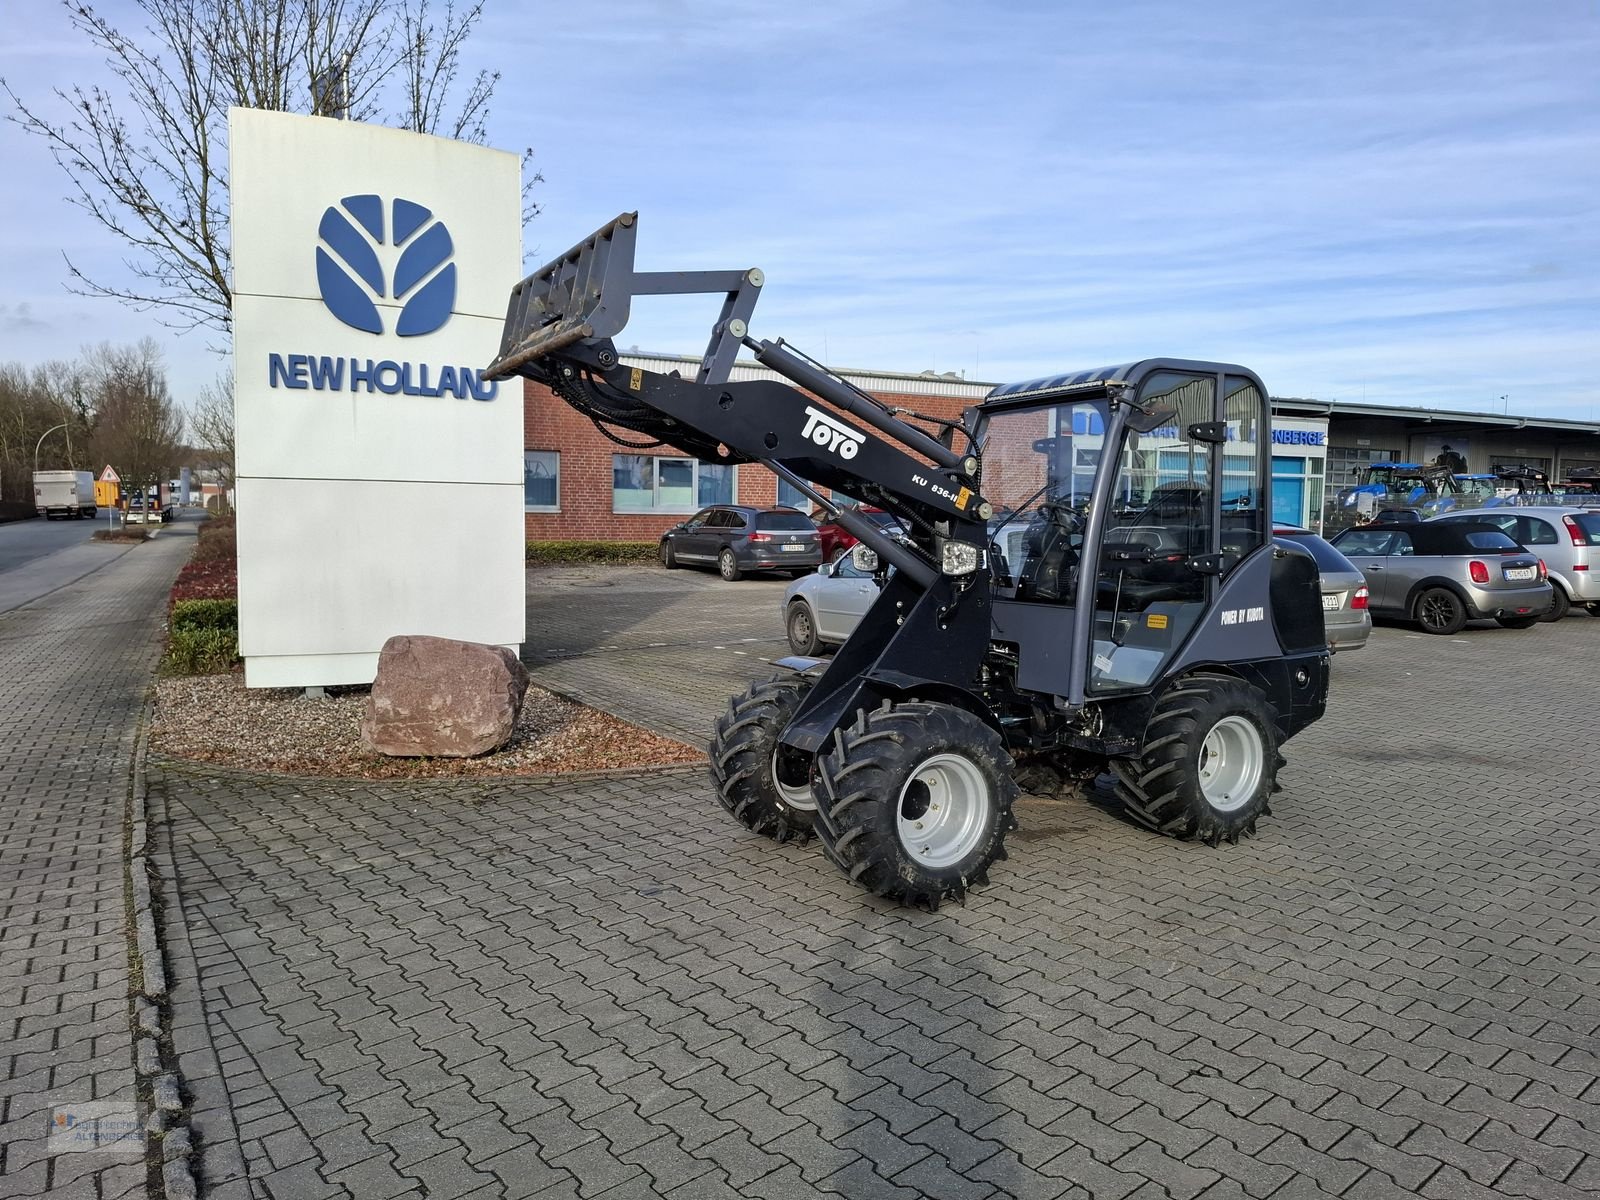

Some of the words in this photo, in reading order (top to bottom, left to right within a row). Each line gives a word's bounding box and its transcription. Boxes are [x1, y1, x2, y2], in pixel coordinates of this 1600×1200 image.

[269, 352, 344, 391] NEW
[351, 357, 499, 401] HOLLAND
[801, 405, 867, 460] TOYO
[911, 474, 928, 487] KU
[1220, 610, 1238, 625] POWER
[1238, 609, 1246, 623] BY
[1246, 606, 1264, 622] KUBOTA
